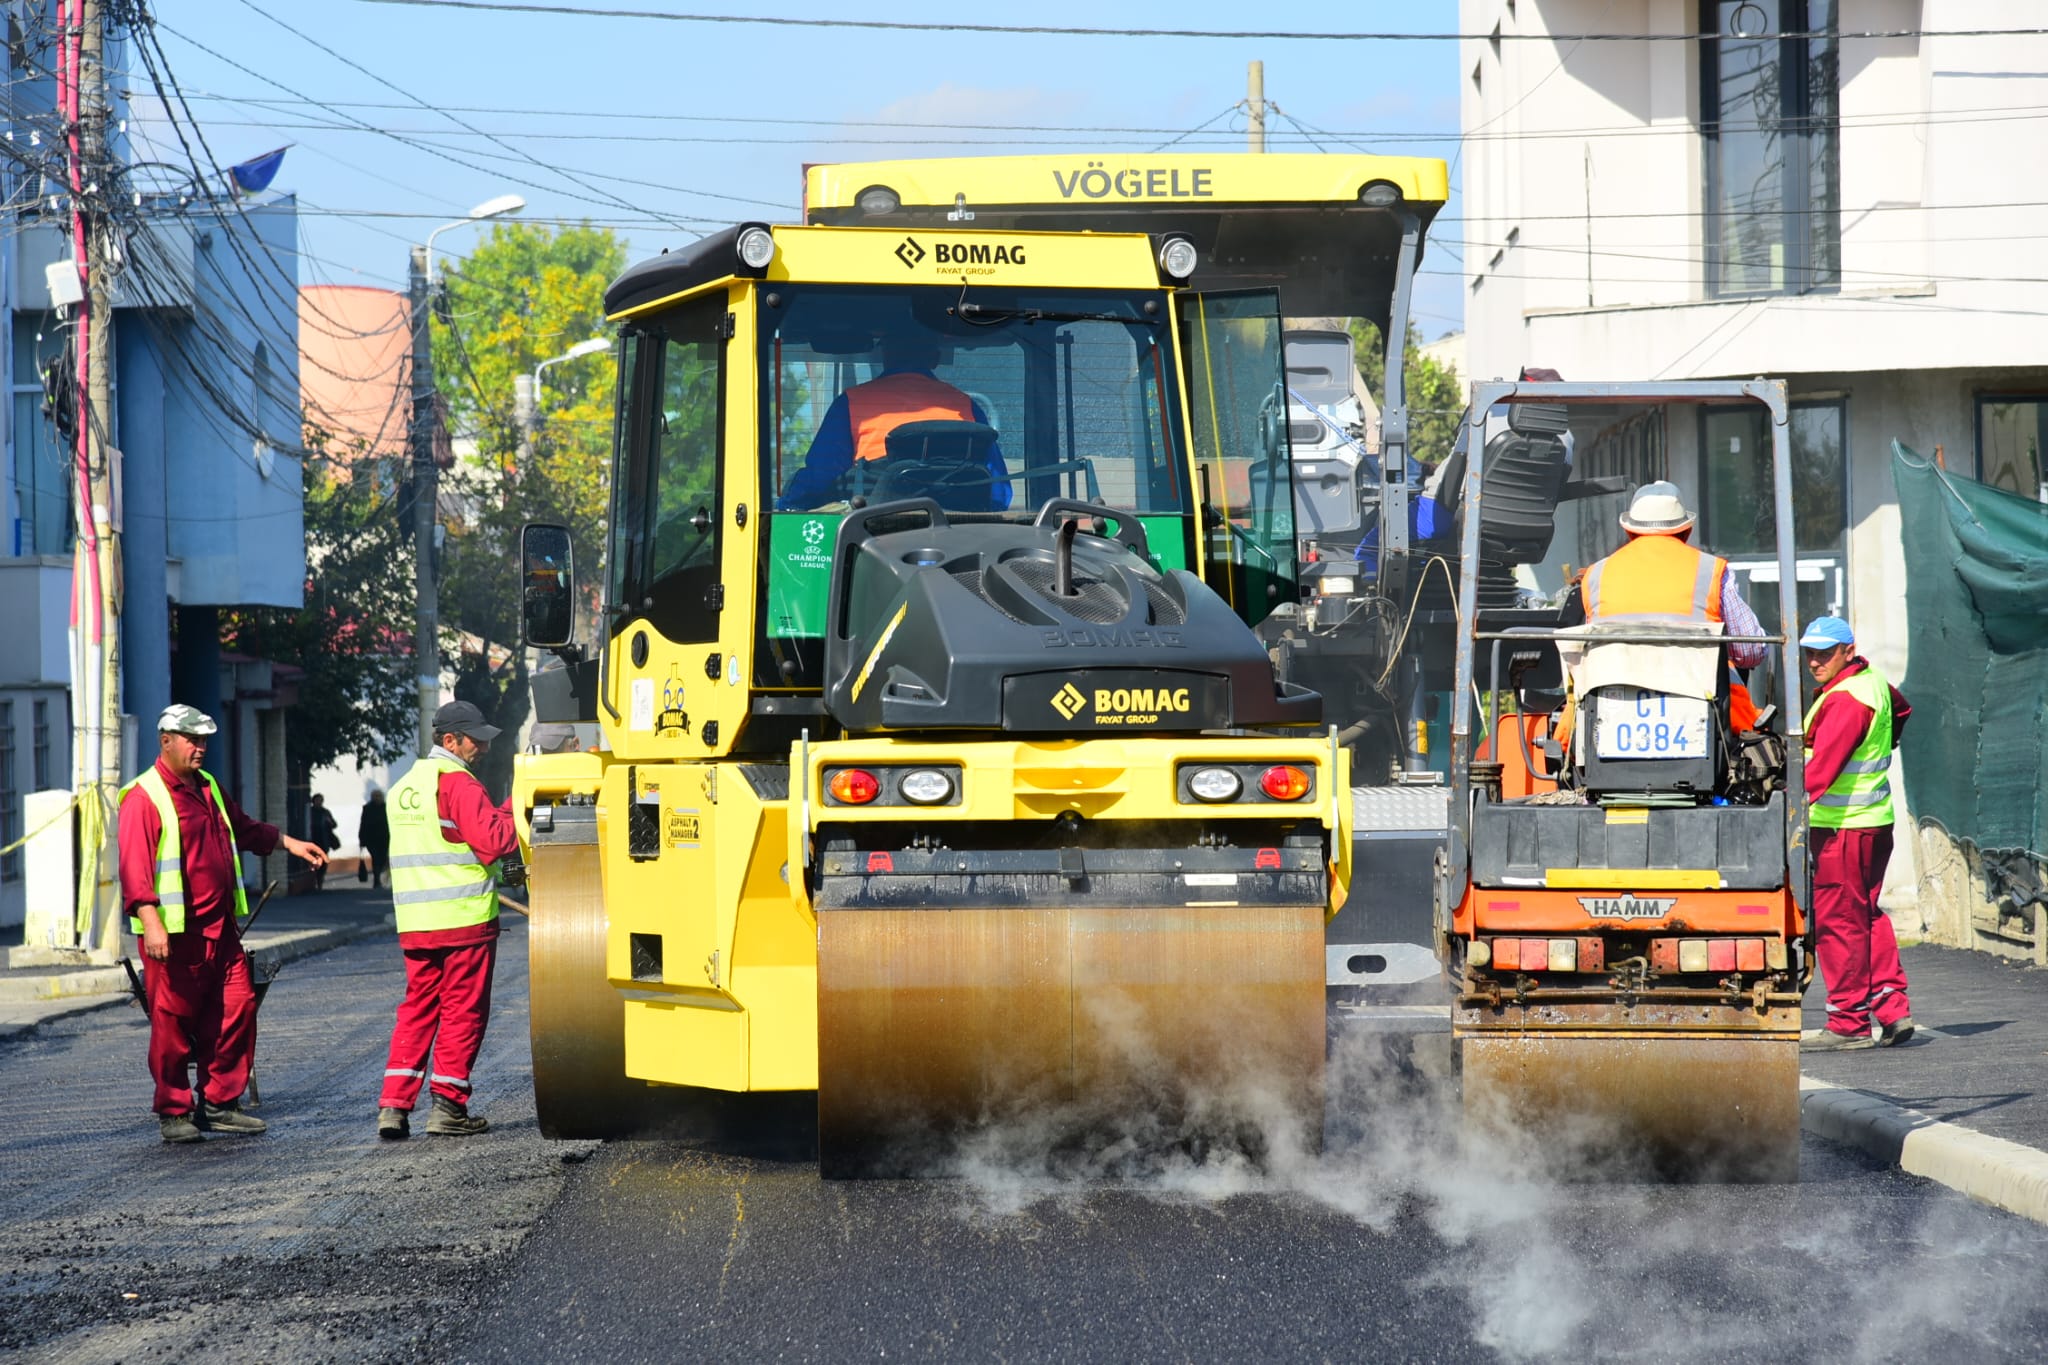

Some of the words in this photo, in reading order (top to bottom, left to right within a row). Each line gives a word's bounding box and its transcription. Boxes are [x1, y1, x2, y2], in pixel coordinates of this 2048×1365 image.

[1053, 161, 1213, 198] VÖGELE
[935, 243, 1026, 265] BOMAG
[936, 267, 962, 275] FAYAT
[965, 267, 996, 275] GROUP
[800, 561, 825, 569] LEAGUE
[1094, 688, 1190, 713] BOMAG
[1636, 689, 1666, 718] CT
[1095, 715, 1124, 724] FAYAT
[1126, 714, 1159, 724] GROUP
[1616, 723, 1689, 752] 0384
[671, 817, 692, 828] ASPHALT
[693, 818, 699, 839] 2
[670, 829, 693, 839] MANAGER
[1594, 900, 1660, 916] HAMM
